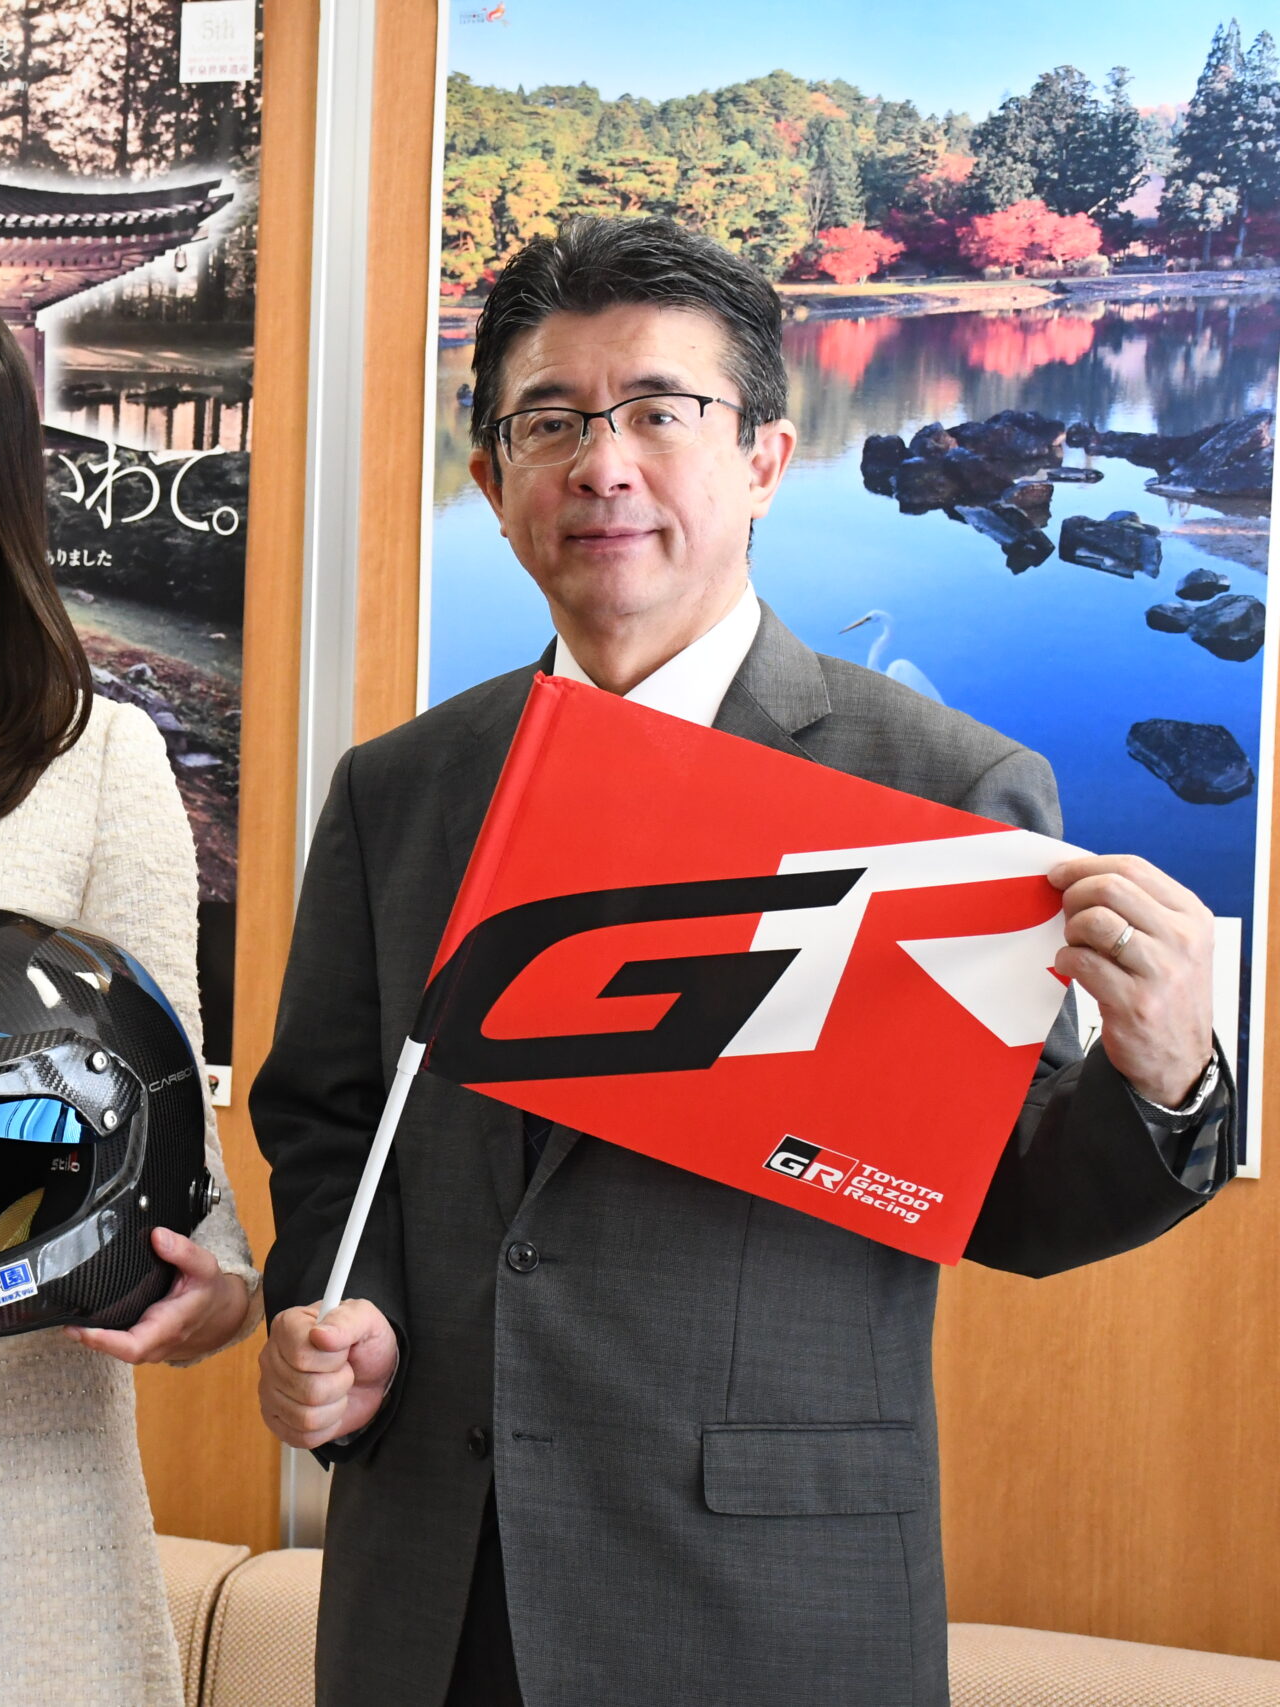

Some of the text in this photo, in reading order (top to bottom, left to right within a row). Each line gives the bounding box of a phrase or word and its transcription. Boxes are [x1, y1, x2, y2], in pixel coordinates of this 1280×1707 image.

[149, 1065, 195, 1093] CARBO
[769, 1150, 845, 1191] GR
[861, 1163, 945, 1203] TOYOTA
[842, 1185, 921, 1225] Racing
[850, 1175, 930, 1212] GAZOO
